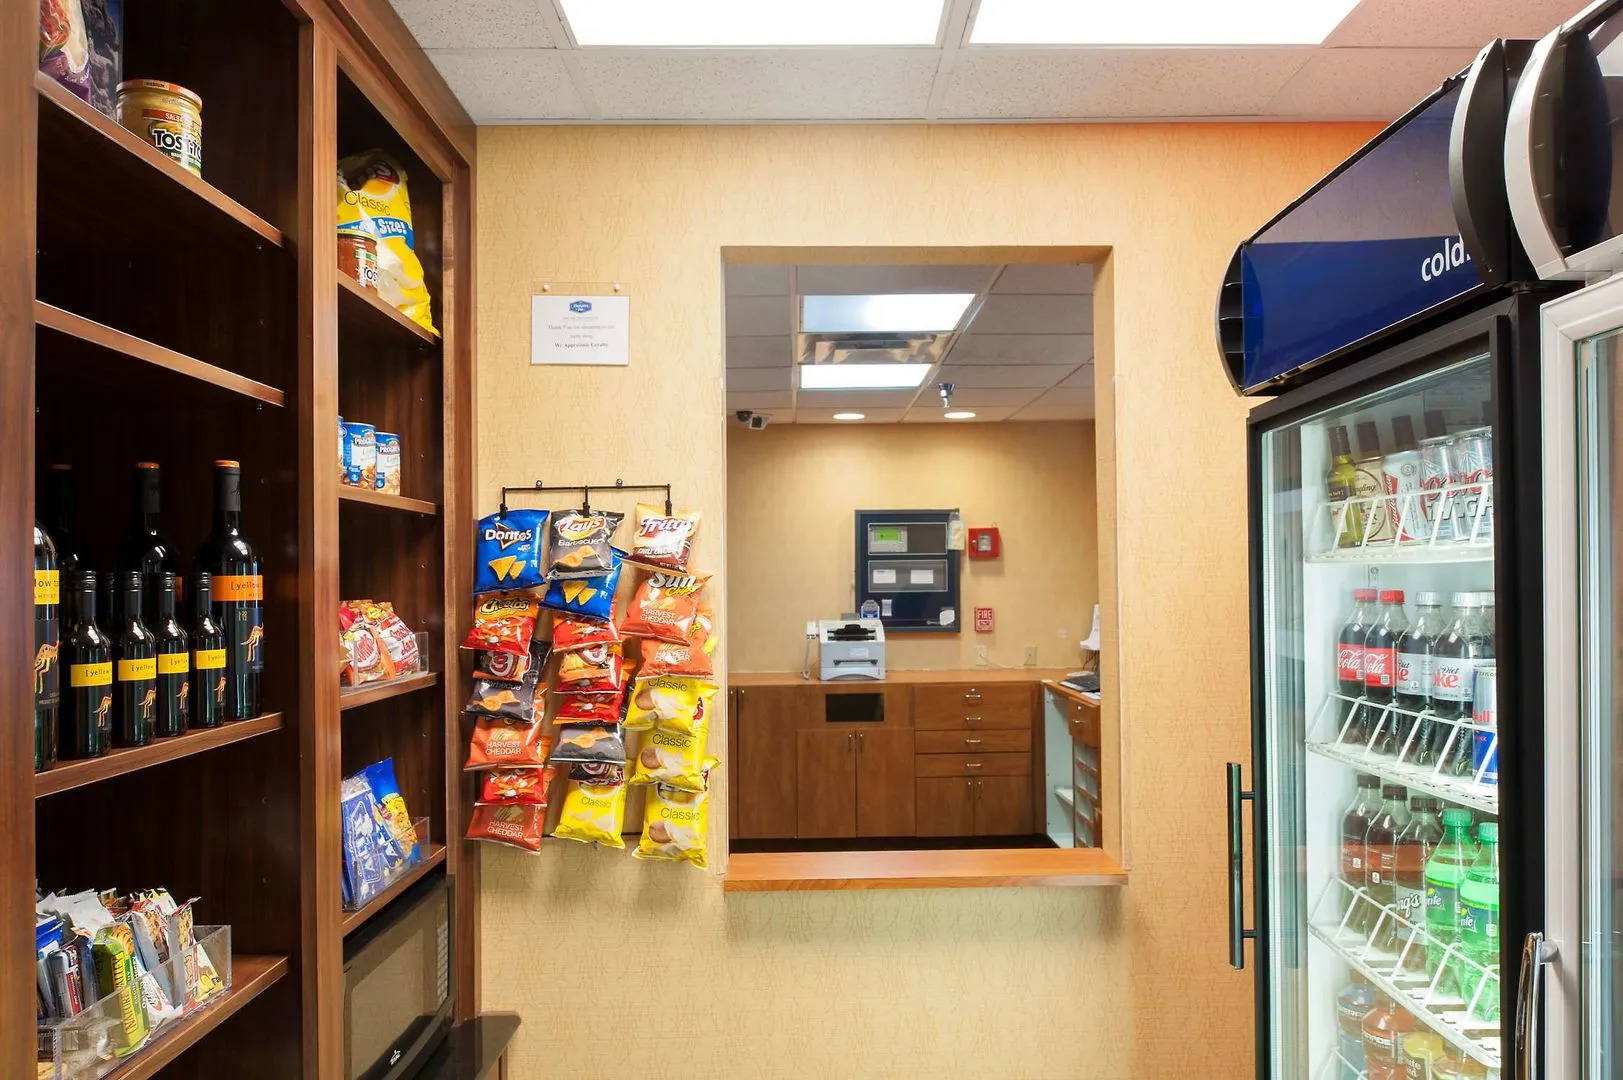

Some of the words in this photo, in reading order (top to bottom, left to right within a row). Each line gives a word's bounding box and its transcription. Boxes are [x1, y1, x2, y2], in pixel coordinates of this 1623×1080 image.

[345, 191, 391, 216] Classic
[379, 218, 406, 234] Size!
[640, 517, 694, 537] Fritos
[485, 529, 532, 541] Doritos
[647, 572, 697, 588] Sun
[480, 598, 529, 614] Cheetos
[642, 608, 676, 619] HARVEST
[640, 615, 676, 626] CHEDDAR
[648, 678, 688, 692] Classic
[487, 741, 521, 749] HARVEST
[652, 733, 692, 748] Classic
[486, 748, 522, 756] CHEDDAR
[581, 796, 612, 809] Classic
[660, 807, 701, 821] Classic
[487, 826, 523, 838] CHEDDAR
[489, 820, 524, 831] HARVEST
